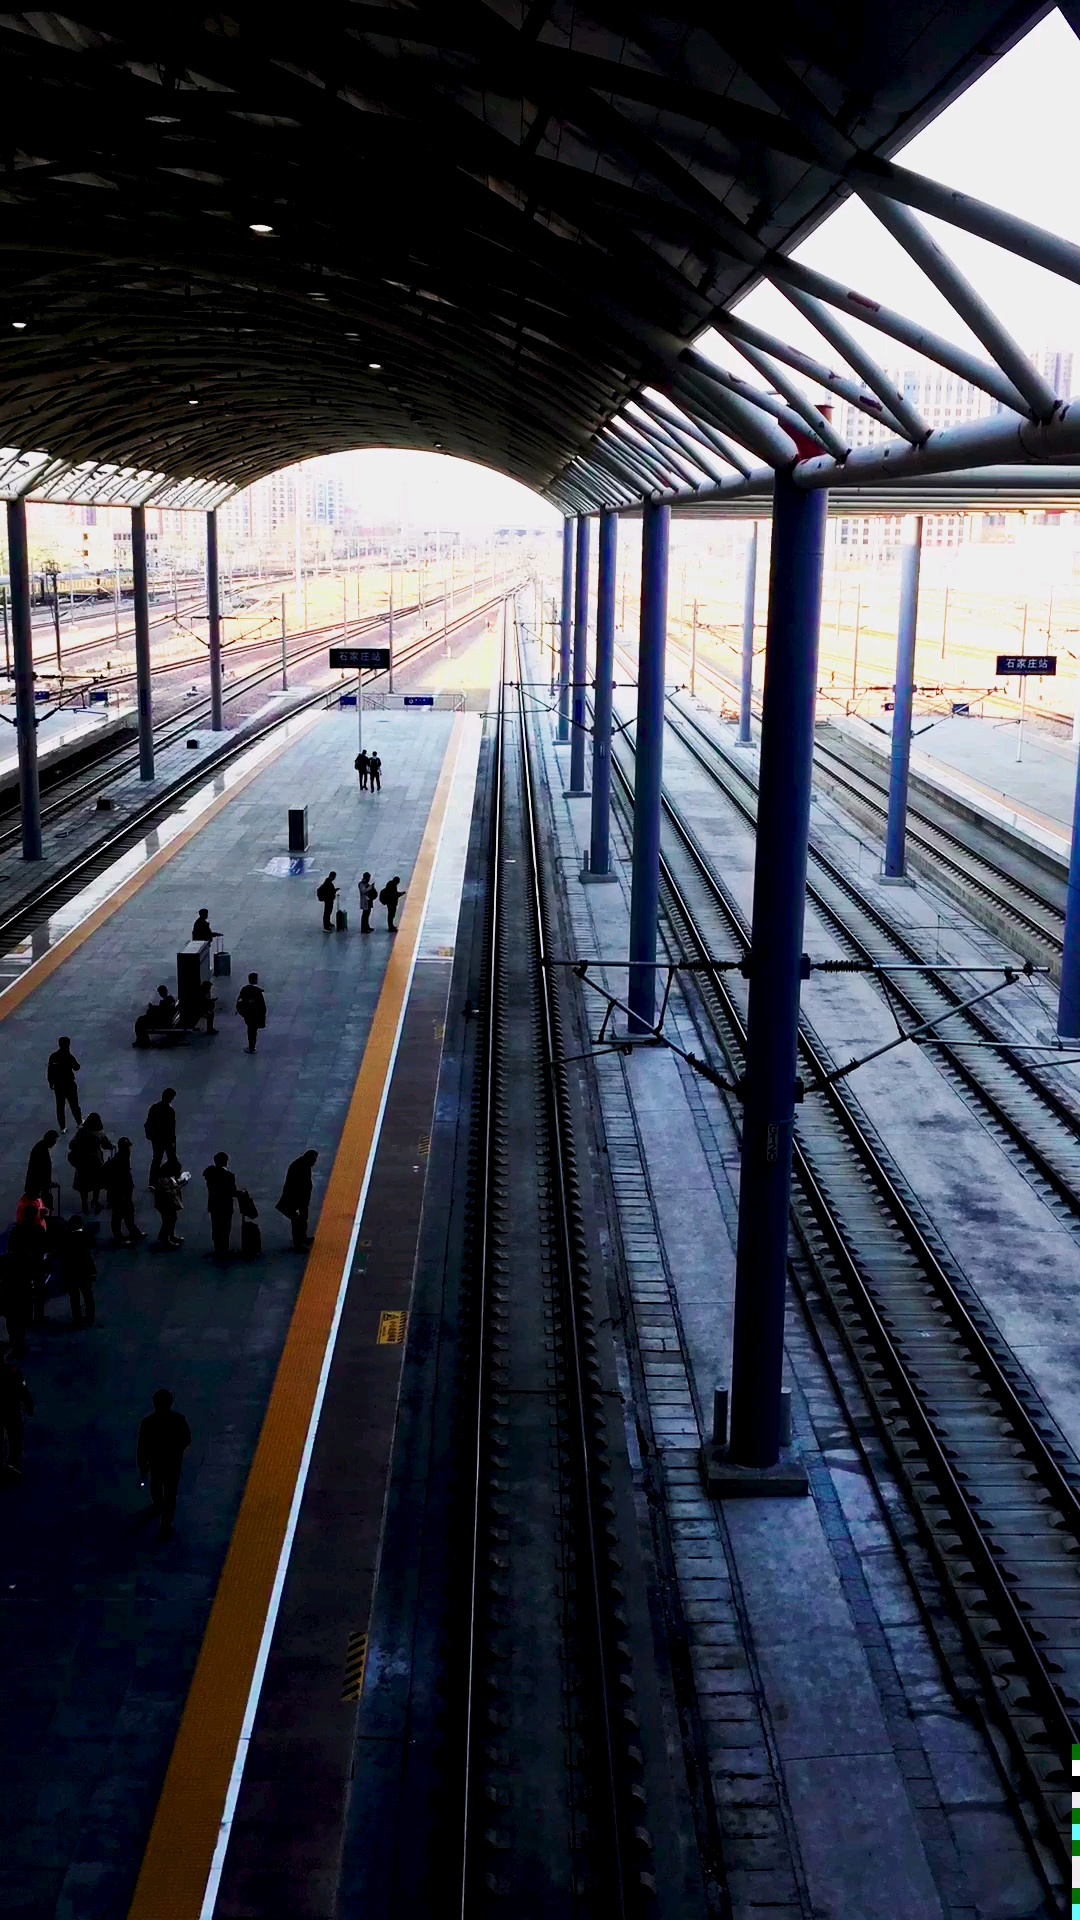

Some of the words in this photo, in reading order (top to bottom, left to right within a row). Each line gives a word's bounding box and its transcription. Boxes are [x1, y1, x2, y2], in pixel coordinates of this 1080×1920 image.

[338, 651, 381, 662] 石家庄站
[1006, 658, 1048, 669] 石家庄站
